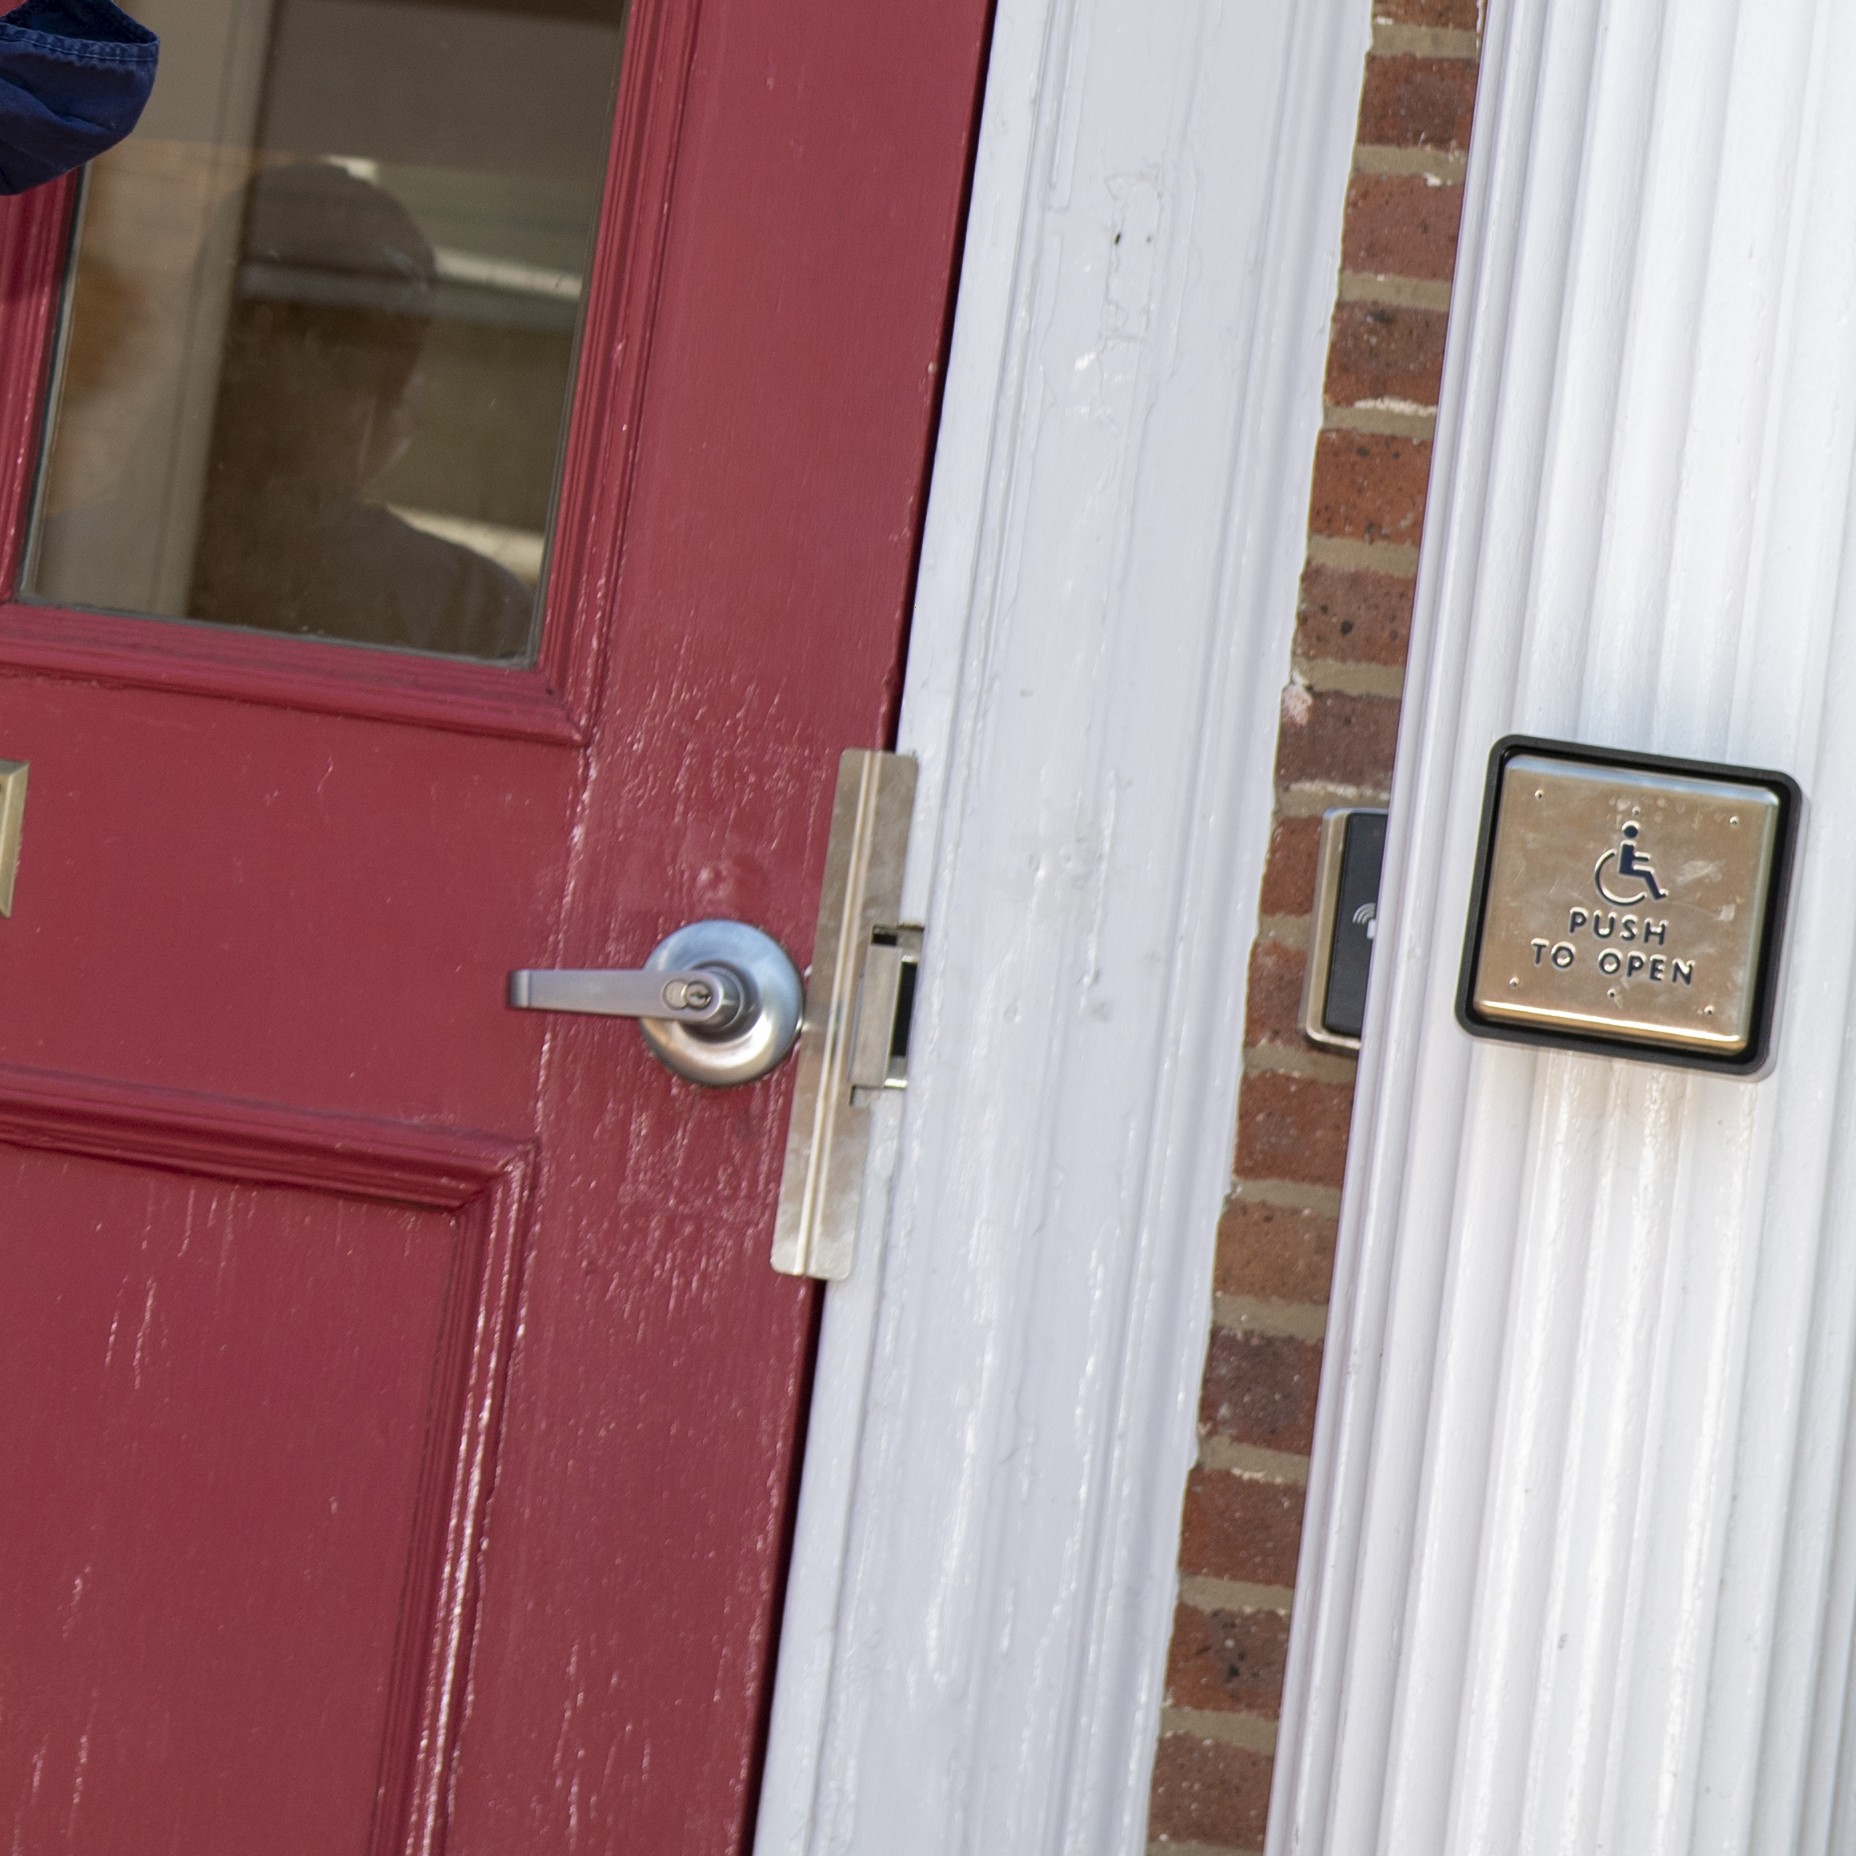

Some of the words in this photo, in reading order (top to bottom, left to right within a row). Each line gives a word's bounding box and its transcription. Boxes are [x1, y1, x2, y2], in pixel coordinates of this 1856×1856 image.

[1569, 906, 1668, 946] PUSH
[1531, 938, 1575, 970] TO
[1598, 950, 1695, 985] OPEN
